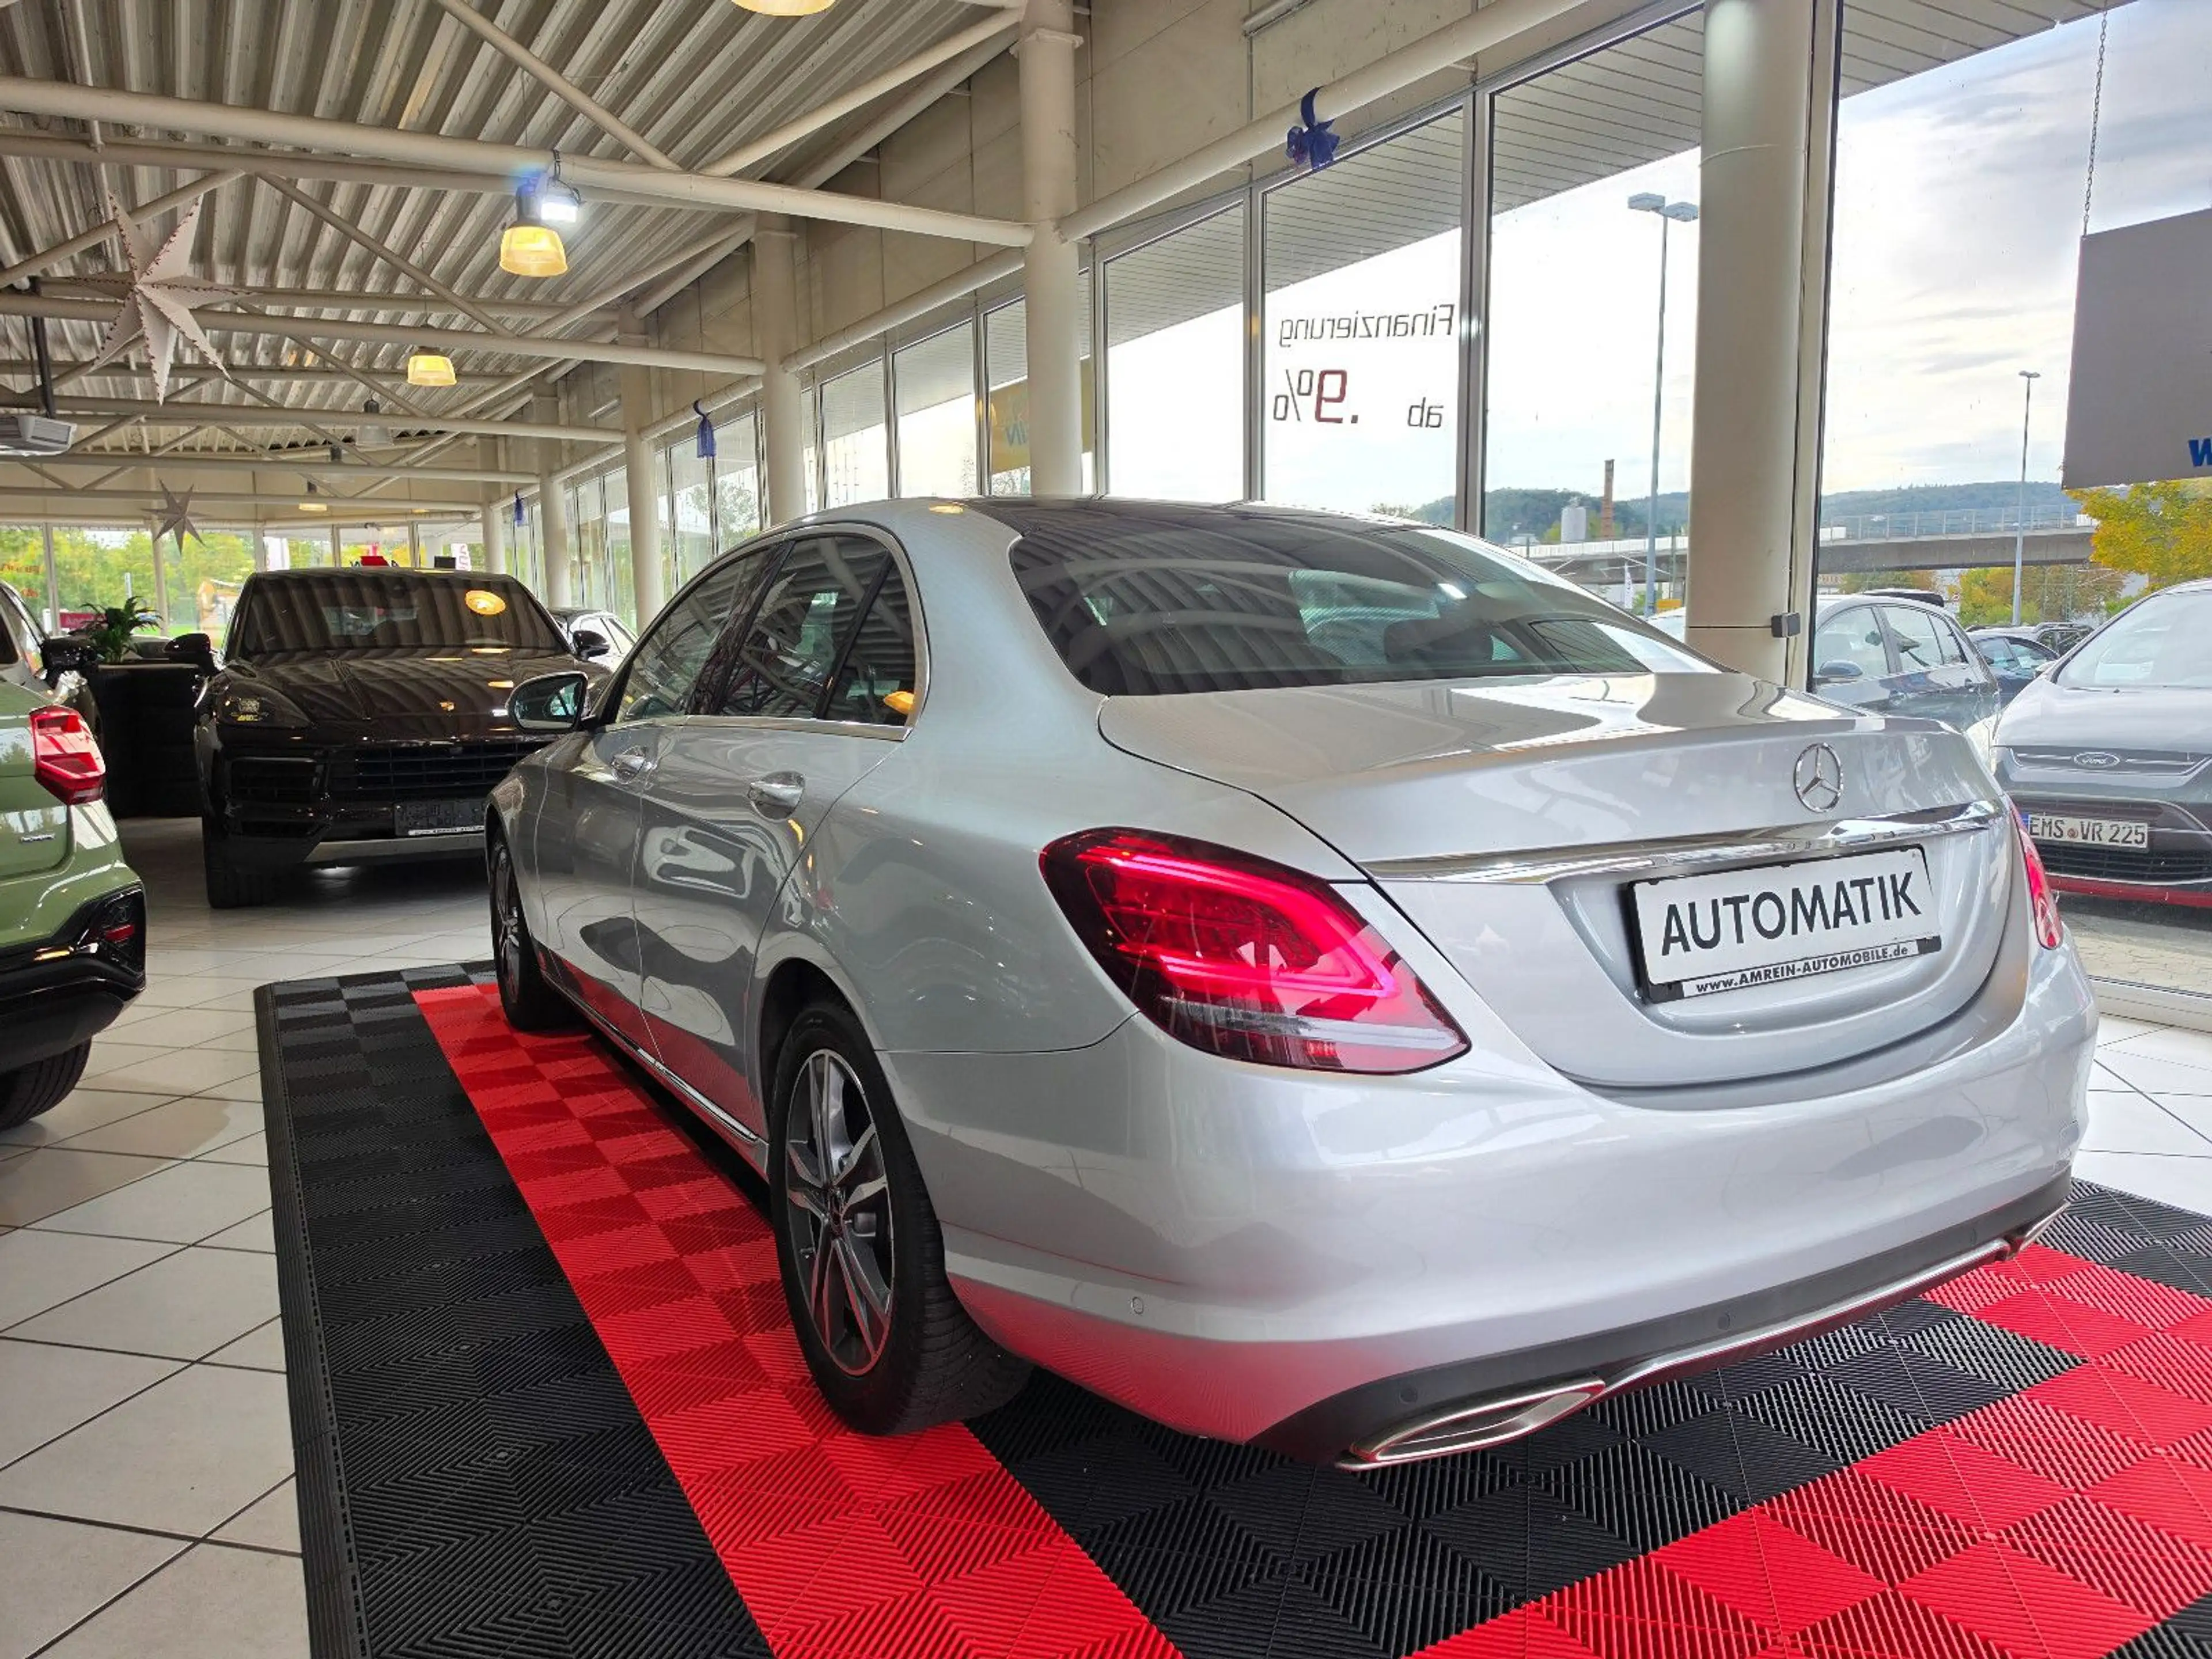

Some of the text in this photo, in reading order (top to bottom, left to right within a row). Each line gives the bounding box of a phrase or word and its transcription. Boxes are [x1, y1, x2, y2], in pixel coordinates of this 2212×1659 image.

[2029, 817, 2146, 845] EMS VR 225
[1661, 871, 1922, 956] AUTOMATIK
[1696, 944, 1908, 994] www.AMREIN-AUTOMOBILE.de
